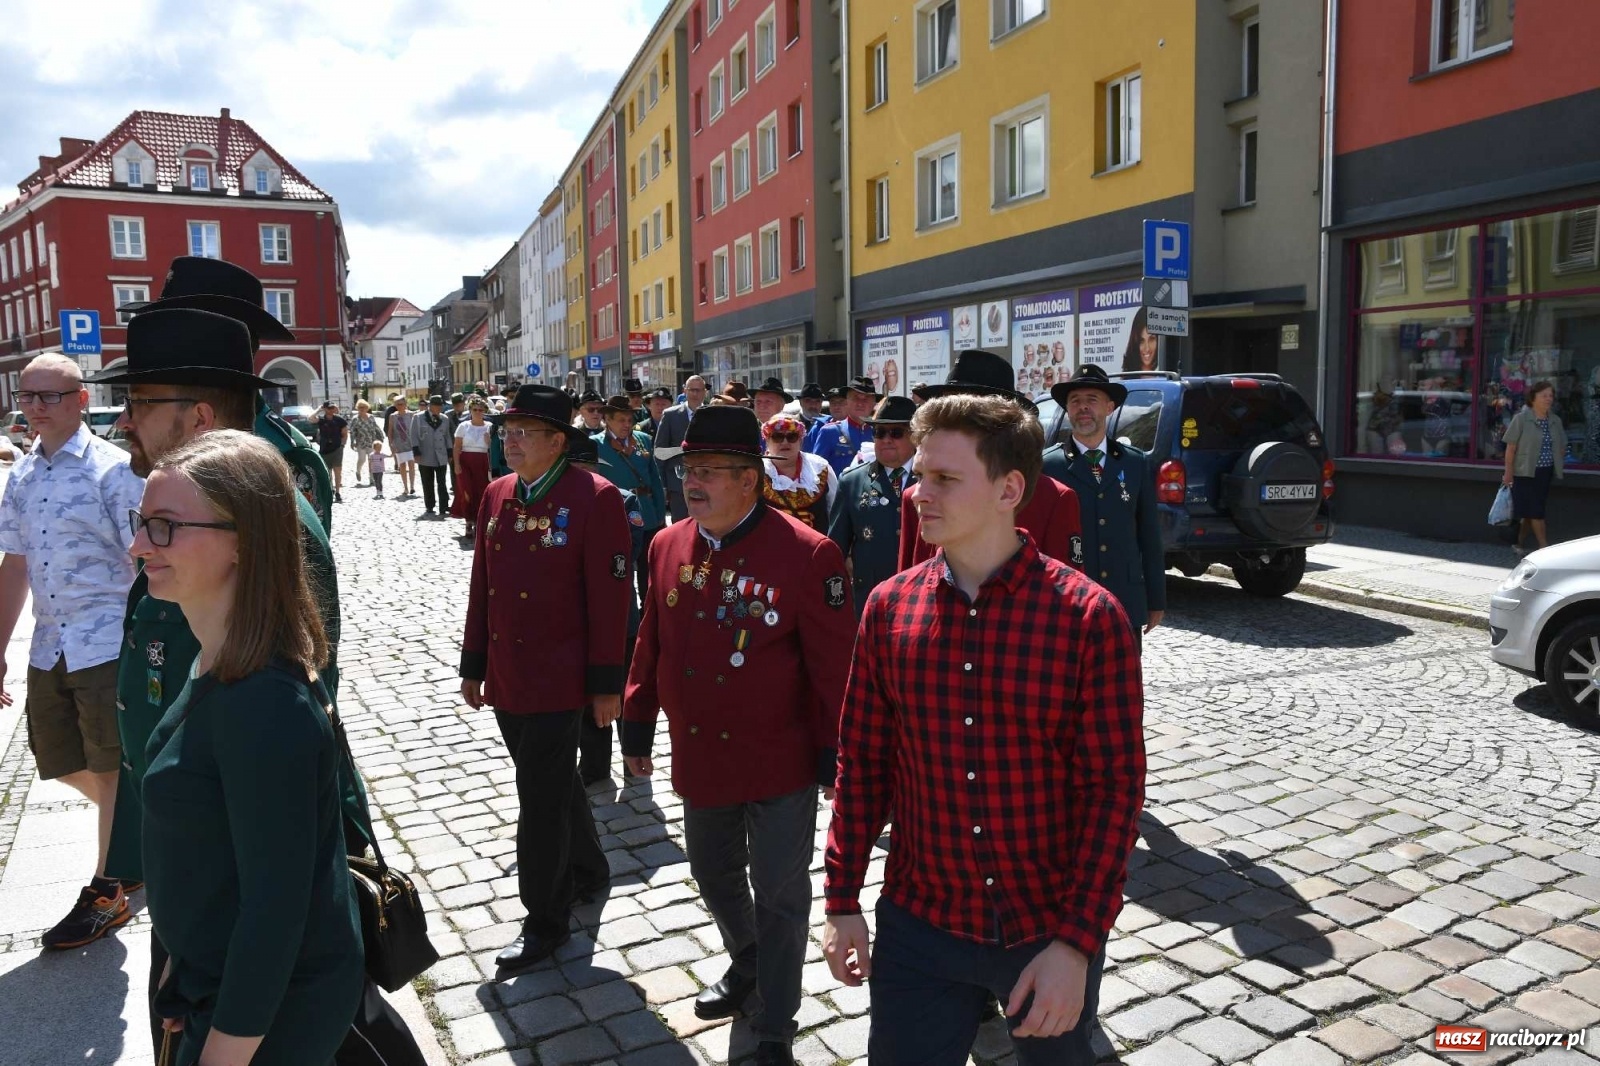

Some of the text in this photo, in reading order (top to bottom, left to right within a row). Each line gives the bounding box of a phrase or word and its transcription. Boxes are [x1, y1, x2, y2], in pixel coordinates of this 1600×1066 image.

[1155, 227, 1181, 271] P
[1015, 297, 1071, 318] STOMATOLOGIA
[1148, 311, 1159, 320] dla
[68, 313, 92, 341] P
[912, 316, 943, 331] PROTETYKA
[1034, 320, 1066, 331] METAMORFOZY
[1092, 319, 1103, 327] MASZ
[866, 323, 900, 337] STOMATOLOGIA
[1284, 331, 1296, 343] 52
[360, 359, 370, 372] P
[590, 357, 599, 369] P
[1267, 485, 1314, 499] SRC 4YV4
